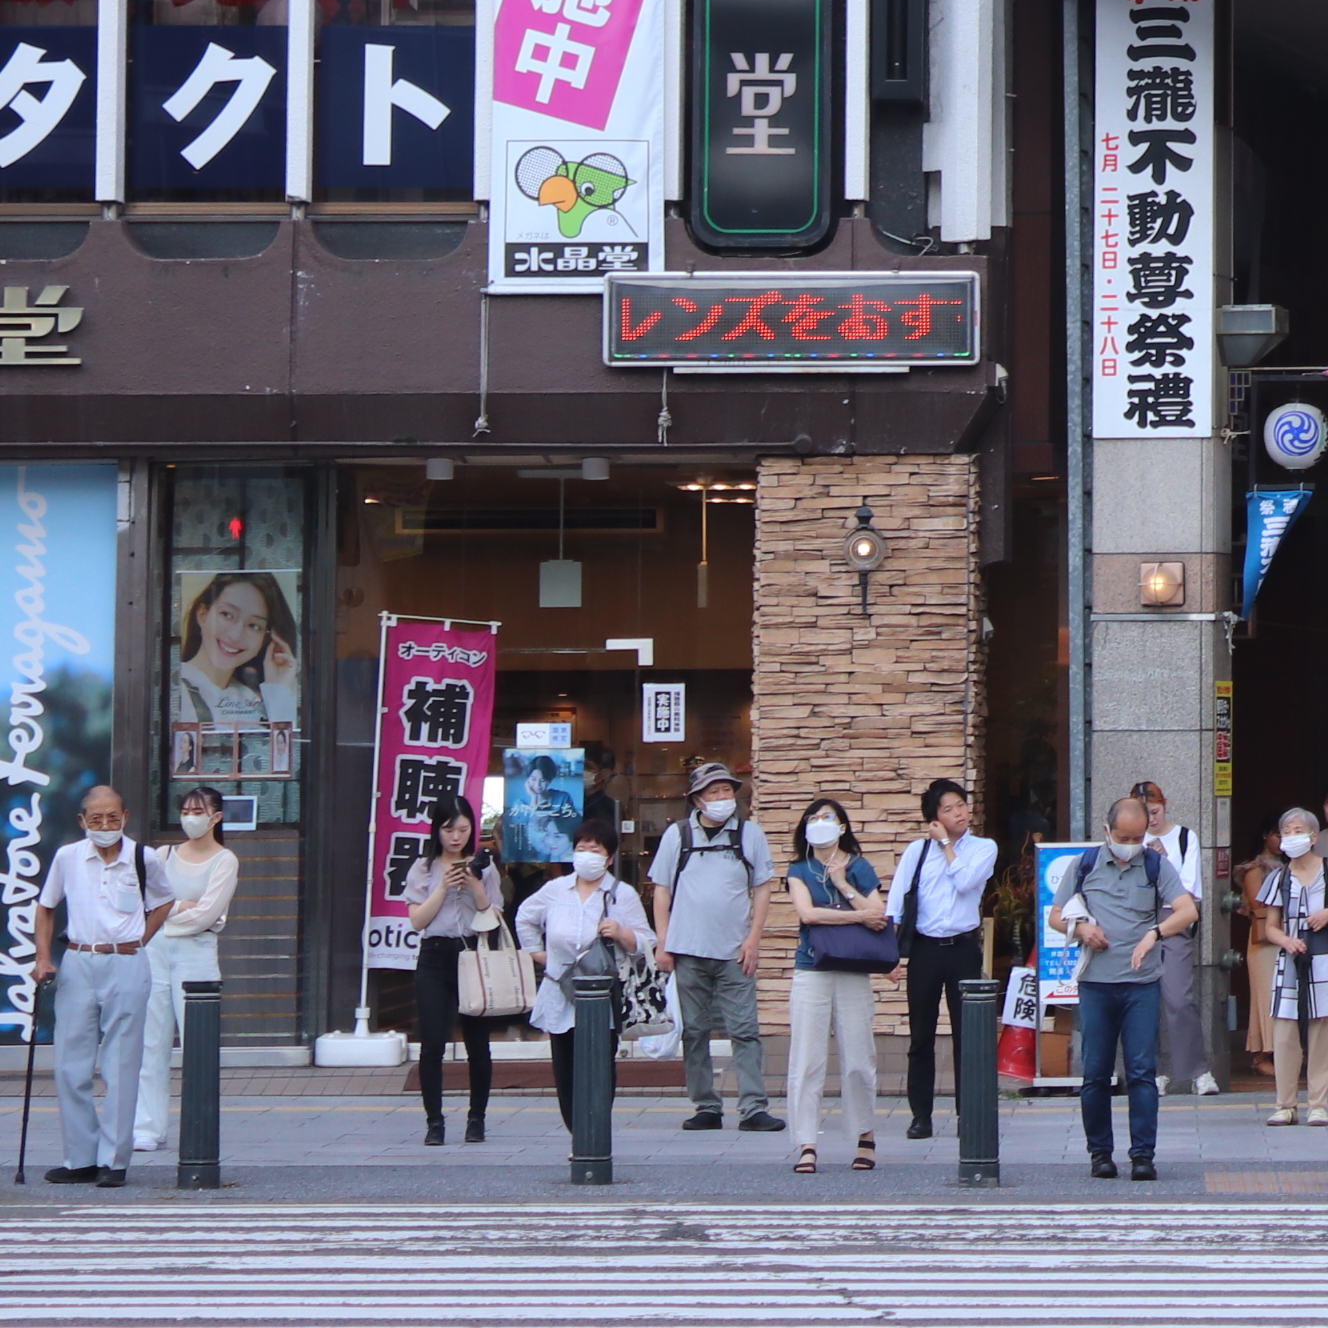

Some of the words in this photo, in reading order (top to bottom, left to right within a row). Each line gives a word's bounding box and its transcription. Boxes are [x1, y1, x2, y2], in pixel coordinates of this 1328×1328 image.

[0, 41, 452, 170] タクト
[513, 245, 640, 272] 水晶堂
[398, 641, 488, 668] オーティコン
[368, 923, 421, 950] otic
